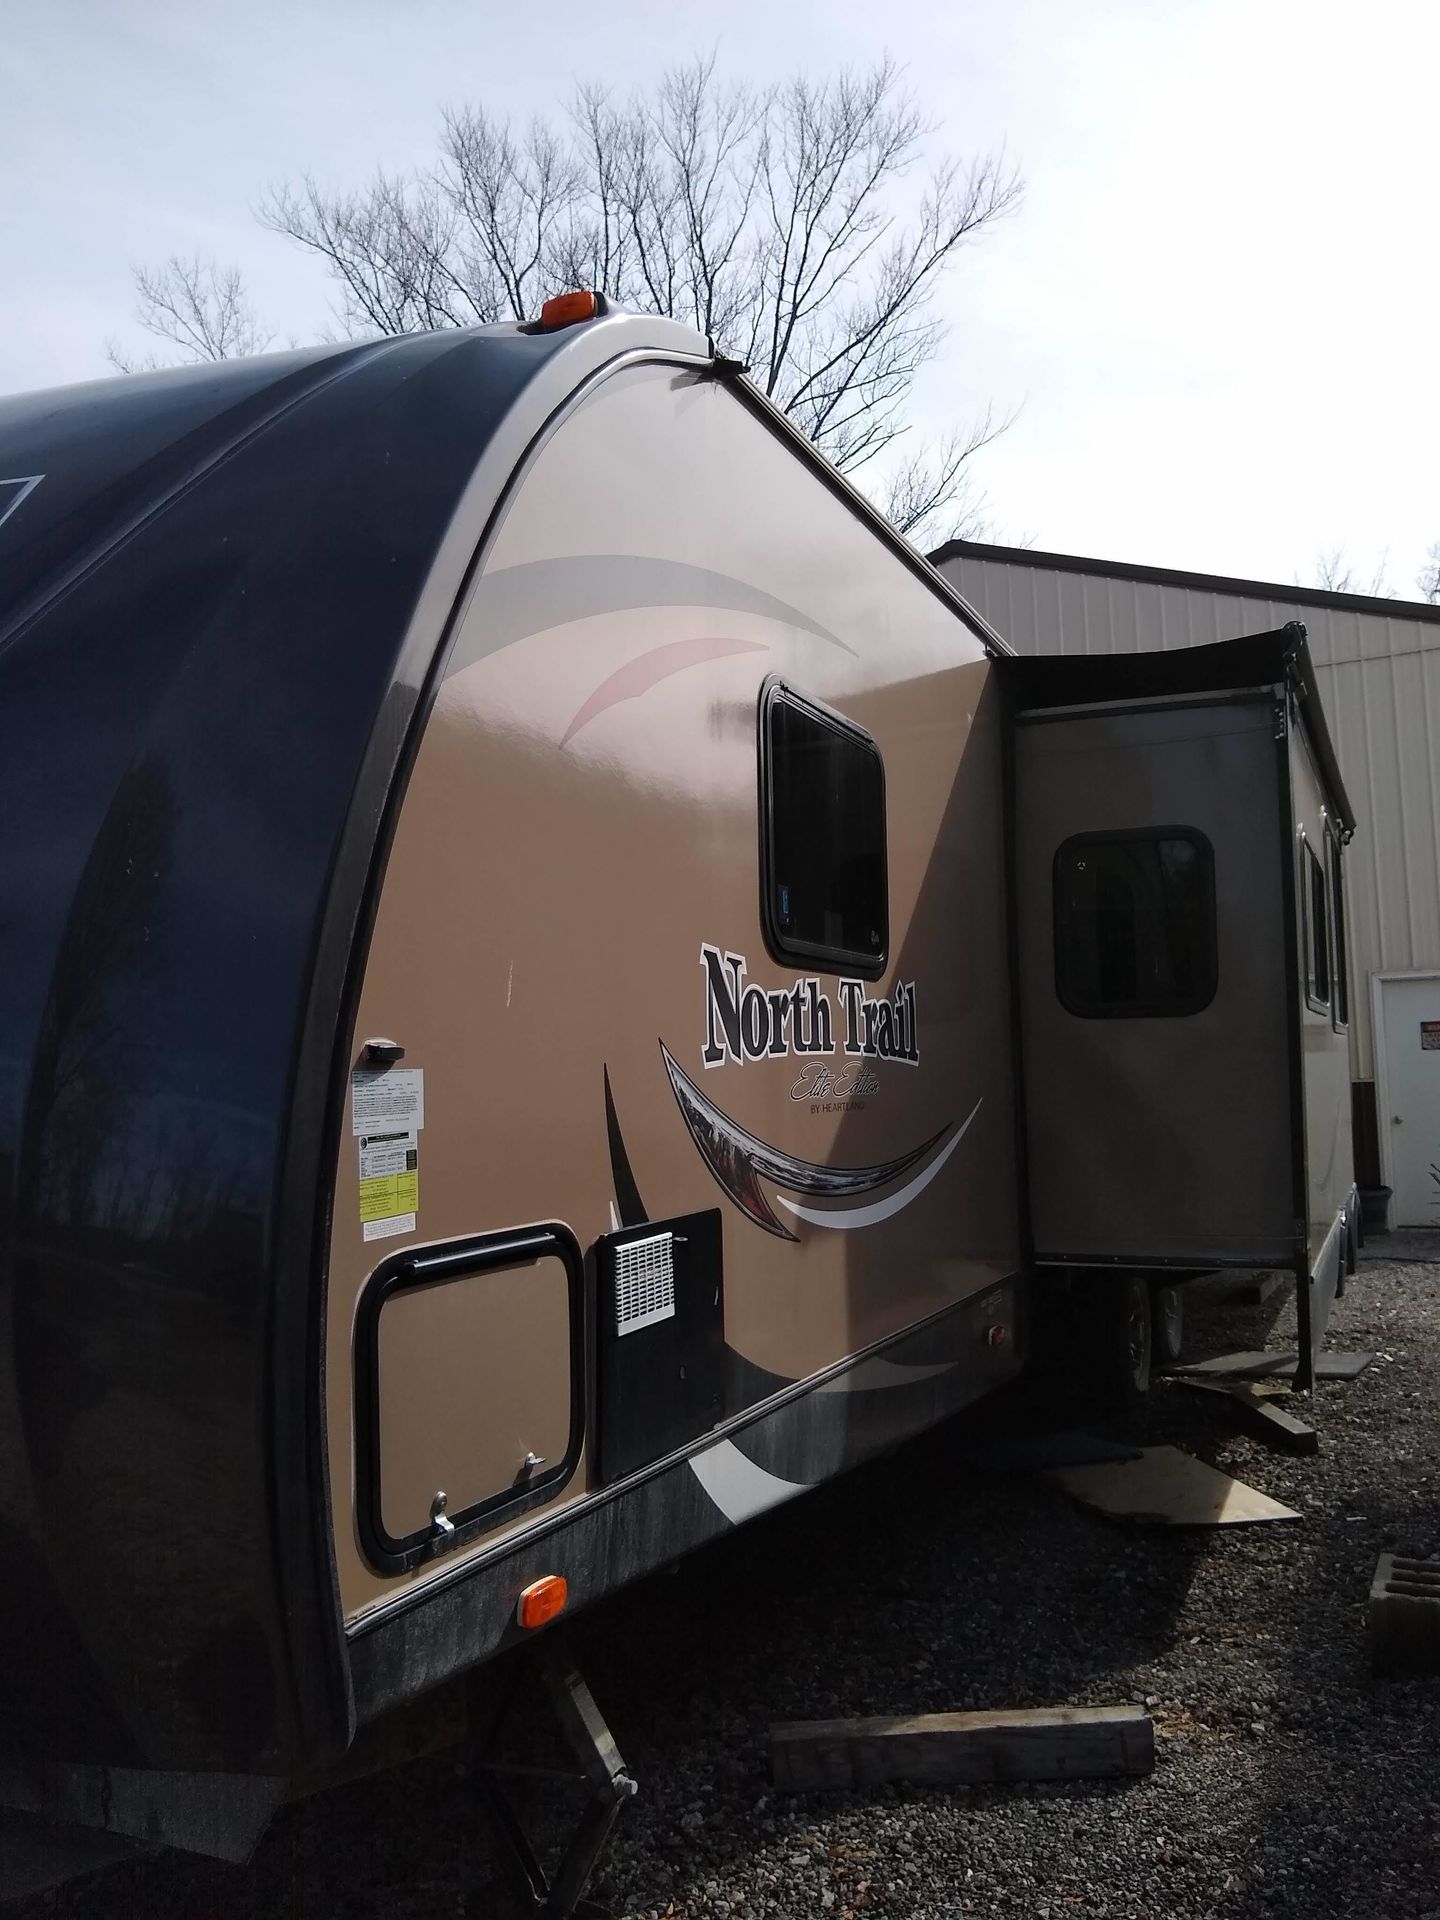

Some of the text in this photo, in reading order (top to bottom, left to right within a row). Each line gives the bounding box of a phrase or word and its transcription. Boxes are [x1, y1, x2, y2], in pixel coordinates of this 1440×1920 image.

[700, 942, 919, 1069] North Trail
[790, 1060, 880, 1101] Elite Edition
[810, 1101, 865, 1114] BY HEARTLAND
